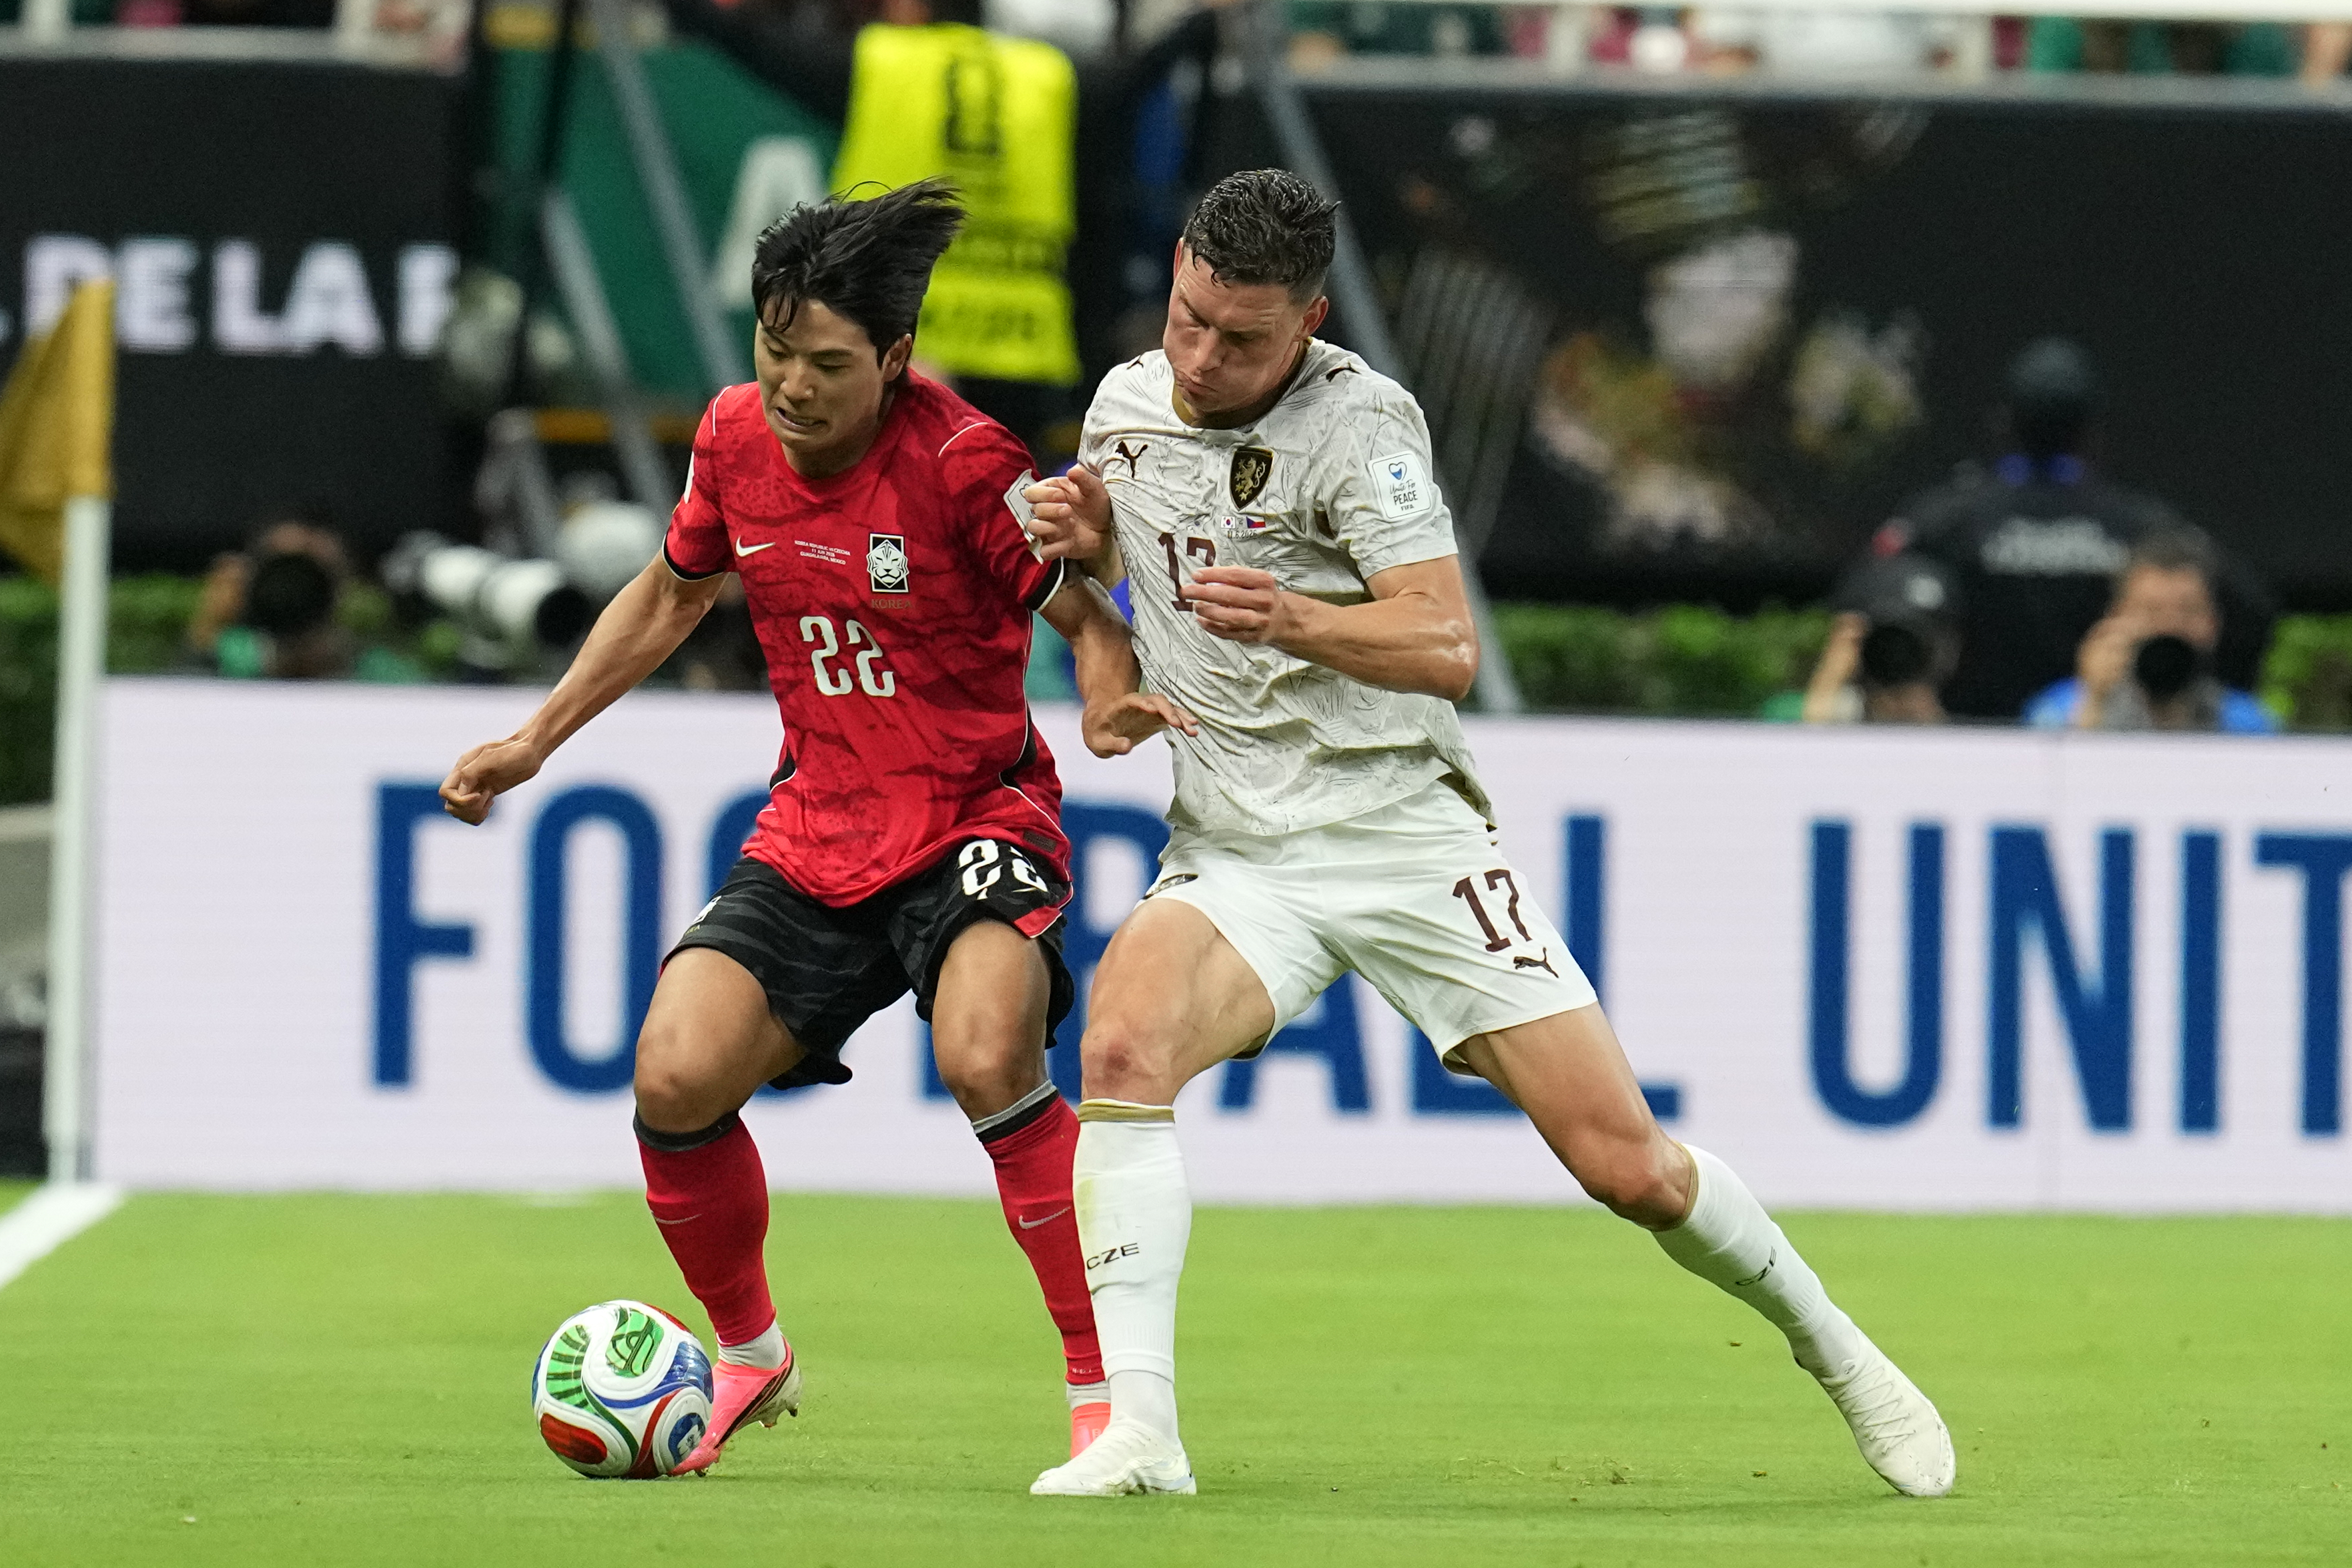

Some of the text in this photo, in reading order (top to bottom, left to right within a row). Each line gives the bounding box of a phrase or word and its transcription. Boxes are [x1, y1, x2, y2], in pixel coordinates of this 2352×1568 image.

[1393, 490, 1418, 505] PEACE
[871, 599, 912, 609] KOREA
[799, 615, 896, 697] 22
[1452, 869, 1533, 952] 17
[1086, 1242, 1140, 1270] CZE
